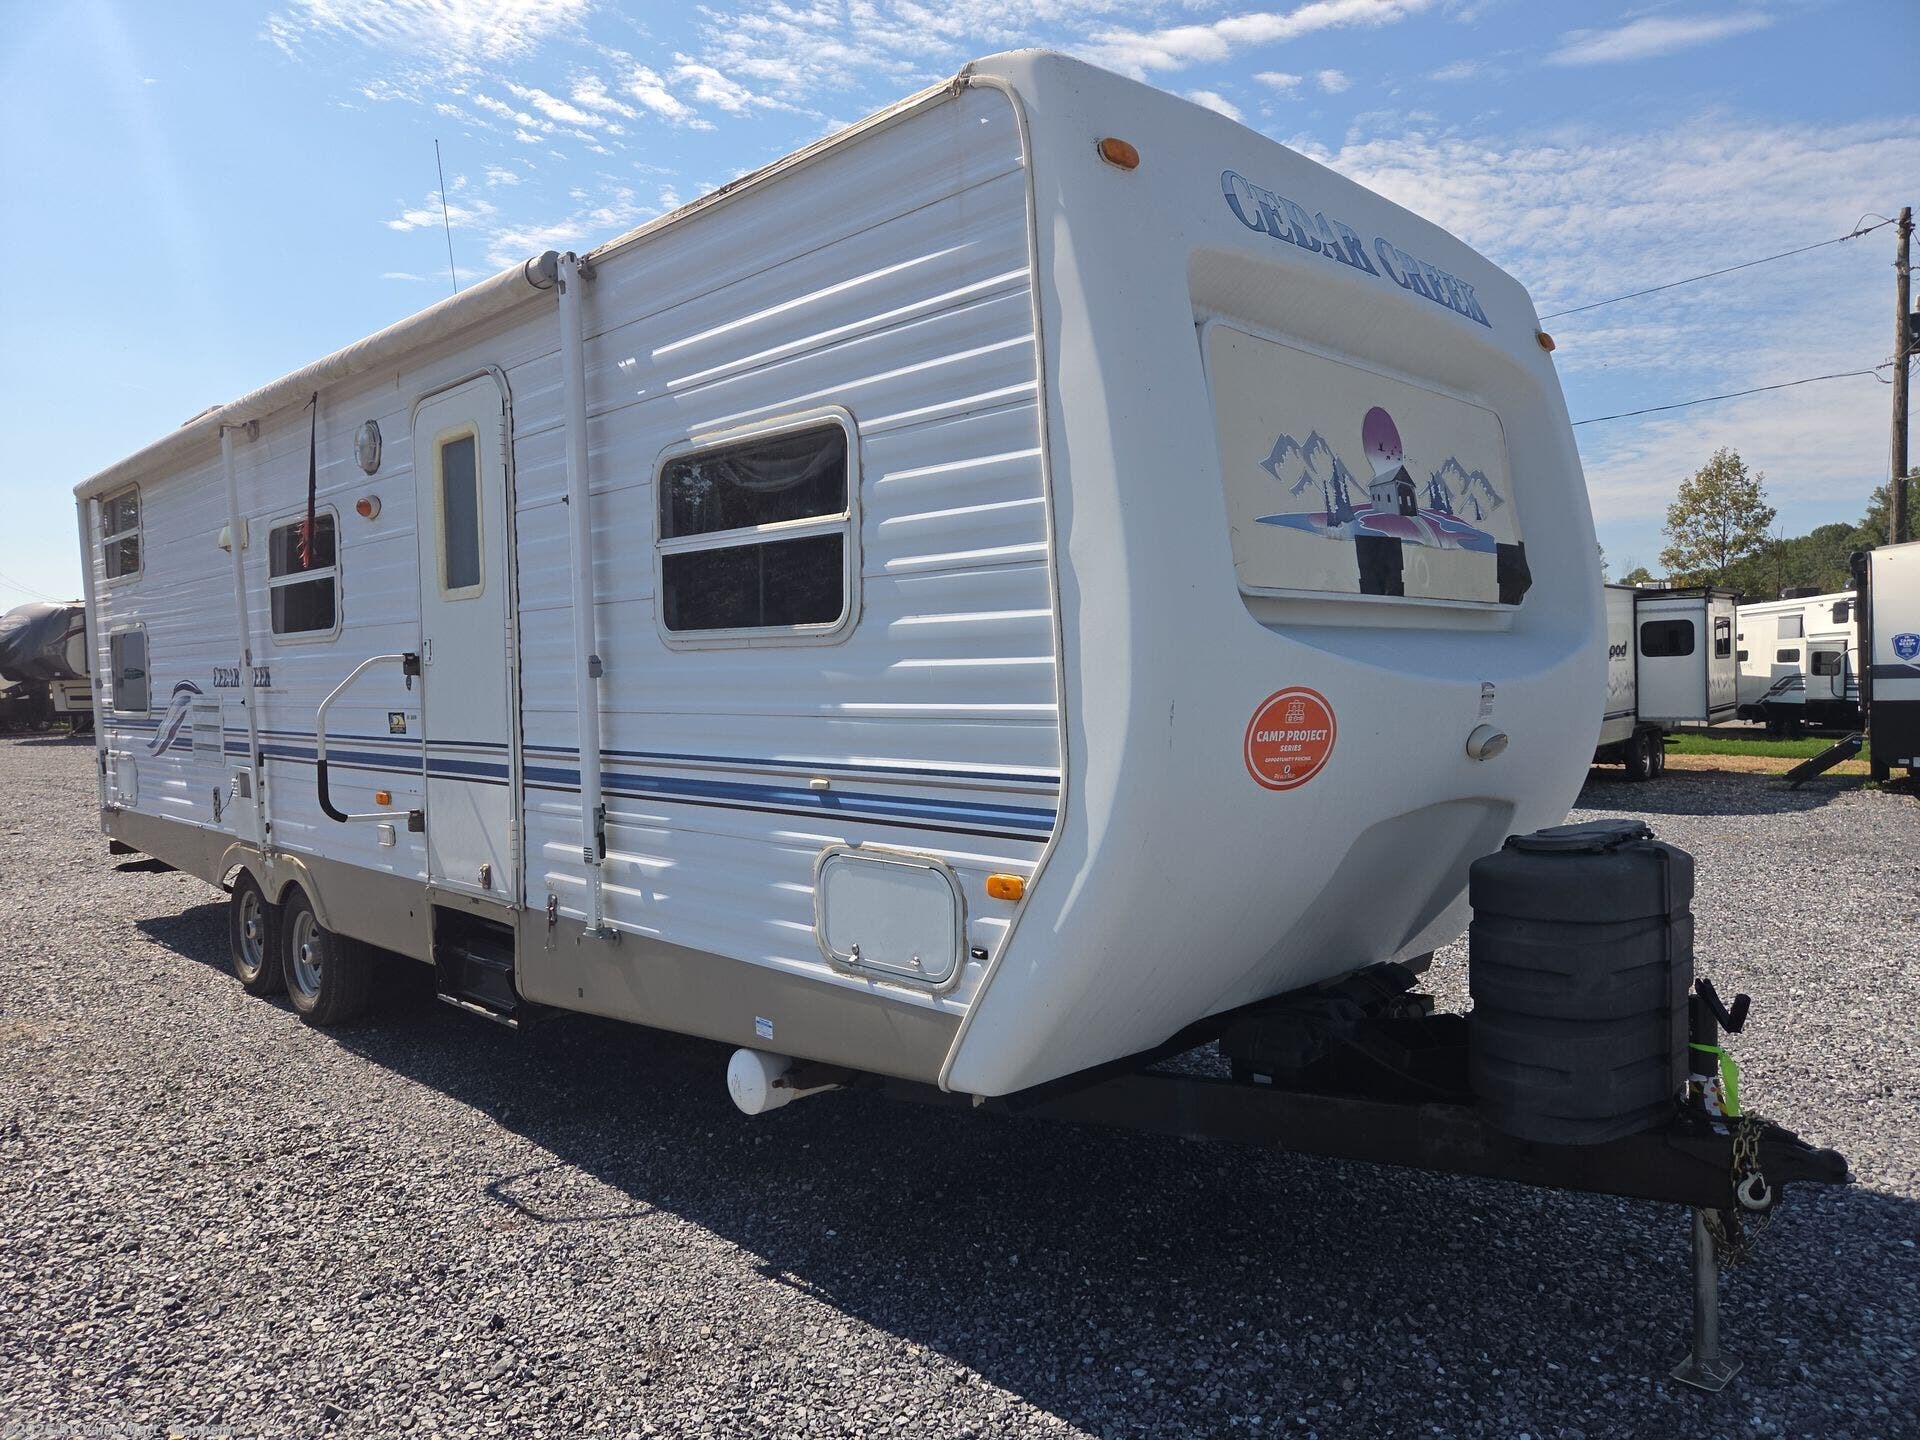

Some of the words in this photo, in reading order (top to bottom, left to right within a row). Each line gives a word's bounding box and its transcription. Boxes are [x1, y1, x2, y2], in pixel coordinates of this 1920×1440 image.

[1220, 169, 1381, 278] CEDAR
[1373, 236, 1493, 329] CREEK
[213, 667, 240, 688] CEDAR
[1256, 730, 1285, 742] CAMP
[1286, 729, 1328, 742] PROJECT
[1279, 744, 1302, 752] SERIES
